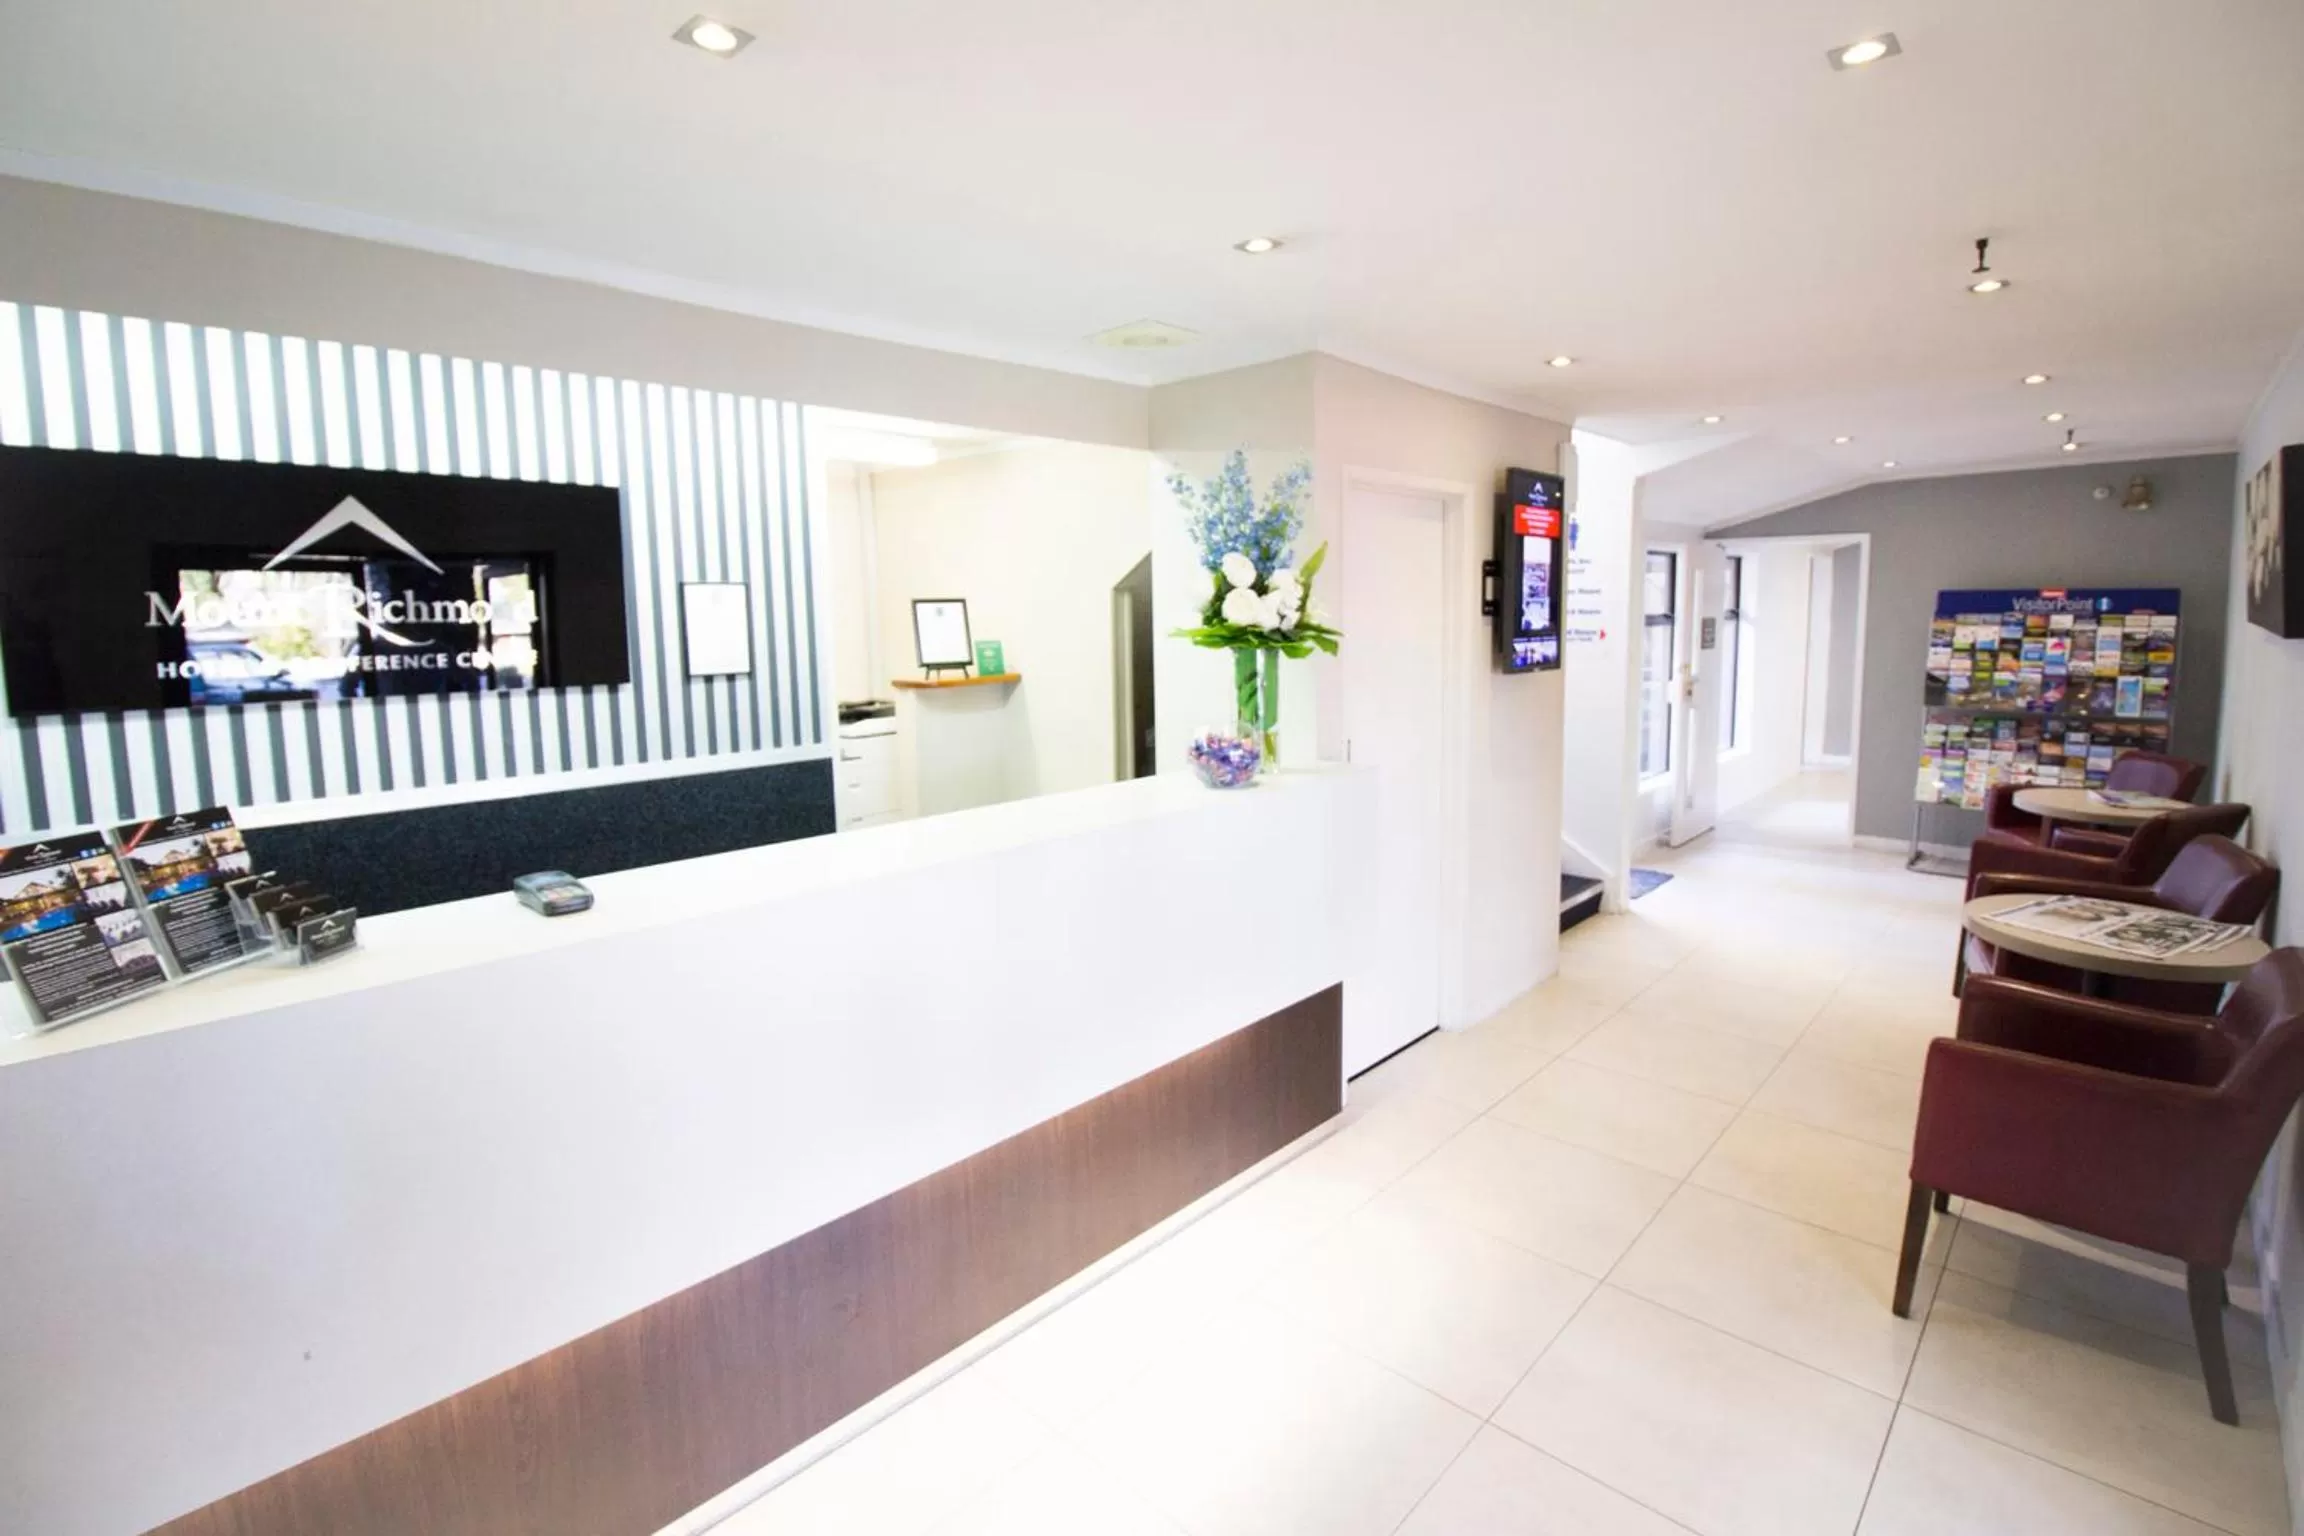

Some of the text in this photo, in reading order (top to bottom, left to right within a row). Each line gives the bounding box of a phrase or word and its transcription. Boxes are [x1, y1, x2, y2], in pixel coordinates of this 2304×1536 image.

[144, 583, 538, 647] Mou Richmod
[293, 652, 449, 678] FERENCE
